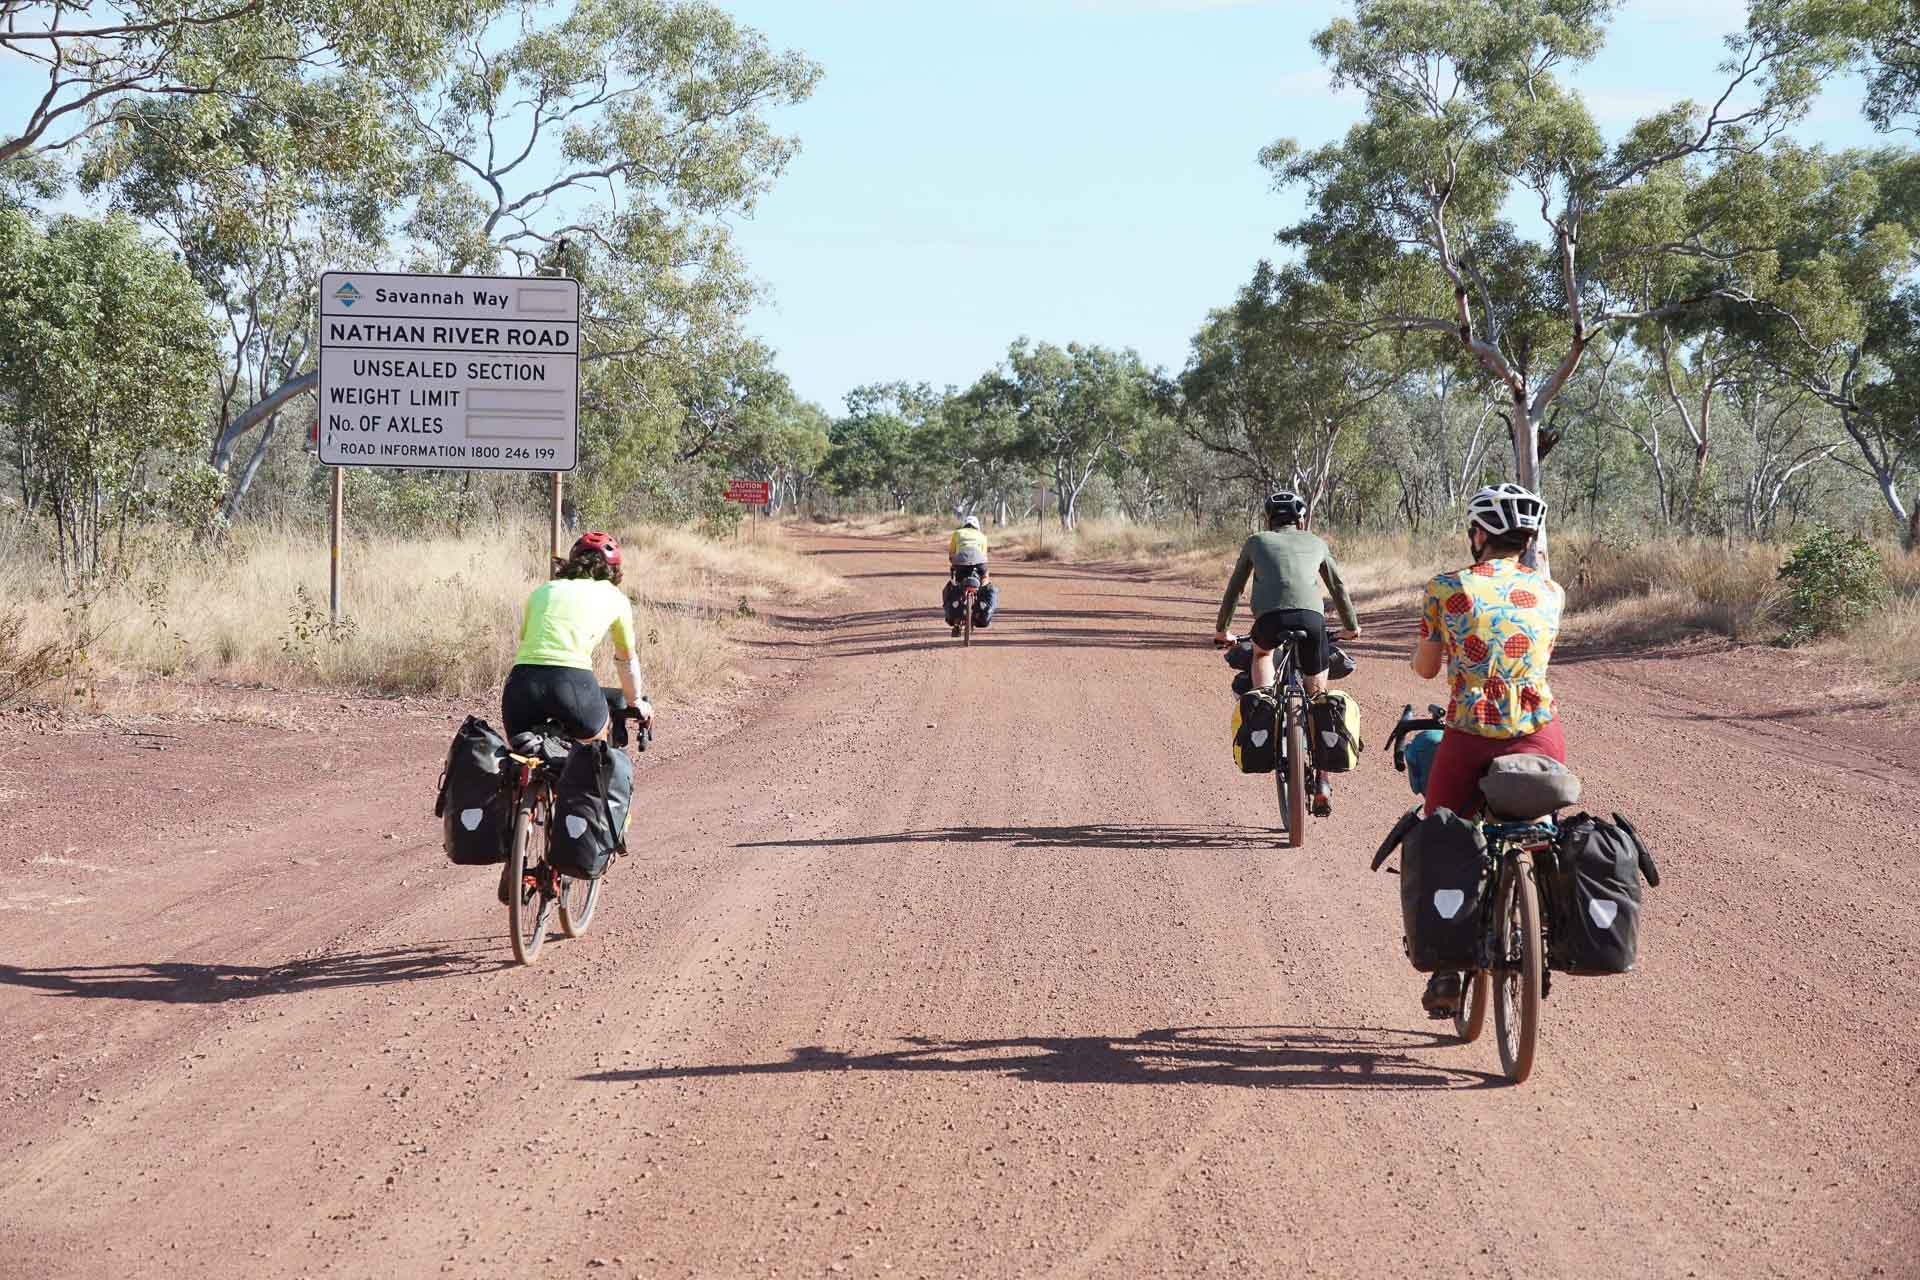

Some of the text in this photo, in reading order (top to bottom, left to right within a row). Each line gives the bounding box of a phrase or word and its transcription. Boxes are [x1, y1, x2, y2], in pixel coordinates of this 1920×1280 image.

[375, 288, 509, 309] Savannah Way
[330, 323, 570, 347] NATHAN RIVER ROAD
[353, 359, 545, 381] UNSEALED SECTION
[330, 387, 461, 407] WEIGHT LIMIT
[329, 414, 443, 434] No. OF AXLES
[340, 442, 555, 460] ROAD INFORMATION 1800 246 199
